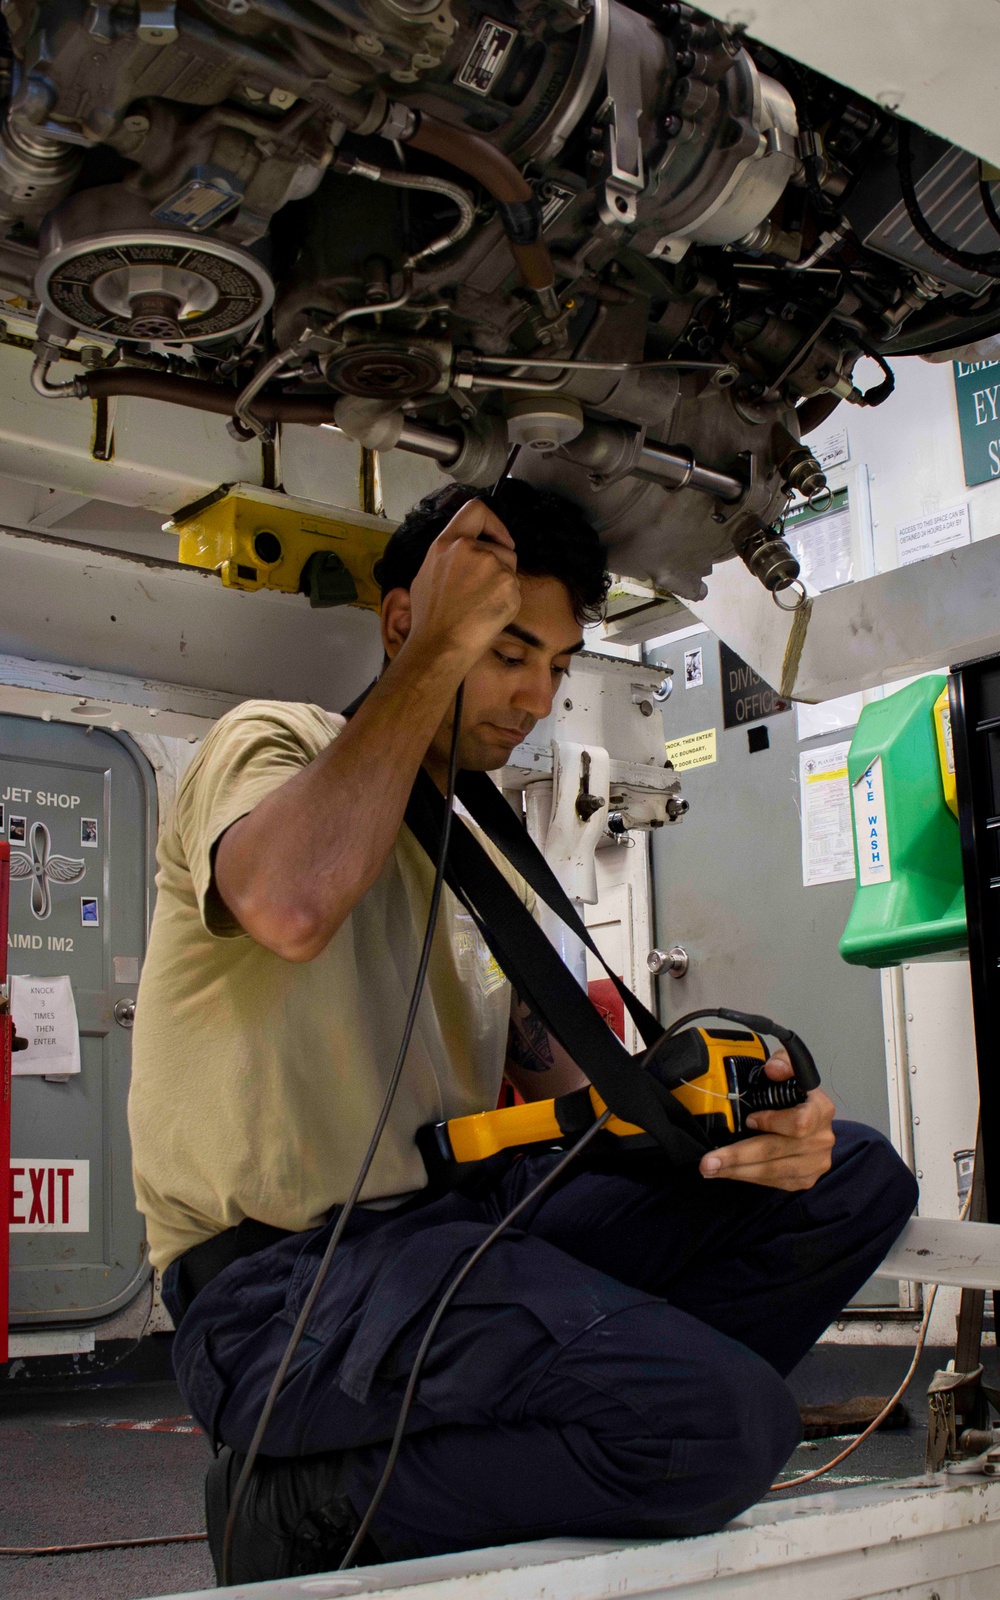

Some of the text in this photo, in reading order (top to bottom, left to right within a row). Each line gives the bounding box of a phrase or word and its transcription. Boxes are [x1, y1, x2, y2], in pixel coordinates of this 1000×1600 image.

[900, 525, 916, 535] ACCESS
[924, 519, 933, 527] THIS
[935, 514, 948, 524] SPACE
[949, 510, 958, 520] CAN
[900, 532, 920, 544] OBTAINED
[921, 530, 926, 538] 24
[927, 524, 943, 535] HOURS
[947, 521, 955, 529] DAY
[901, 543, 930, 555] CONTACTING
[729, 665, 763, 693] DIVIS
[735, 690, 780, 721] OFFICE
[682, 737, 695, 745] THEN
[679, 760, 692, 768] DOOR
[865, 767, 874, 802] EYE
[2, 786, 80, 809] JET SHOP
[868, 815, 880, 863] WASH
[47, 936, 74, 952] IM2
[31, 987, 55, 995] KNOCK
[33, 1012, 56, 1020] TIMES
[36, 1025, 55, 1033] THEN
[33, 1037, 57, 1046] ENTER
[9, 1168, 74, 1224] EXIT
